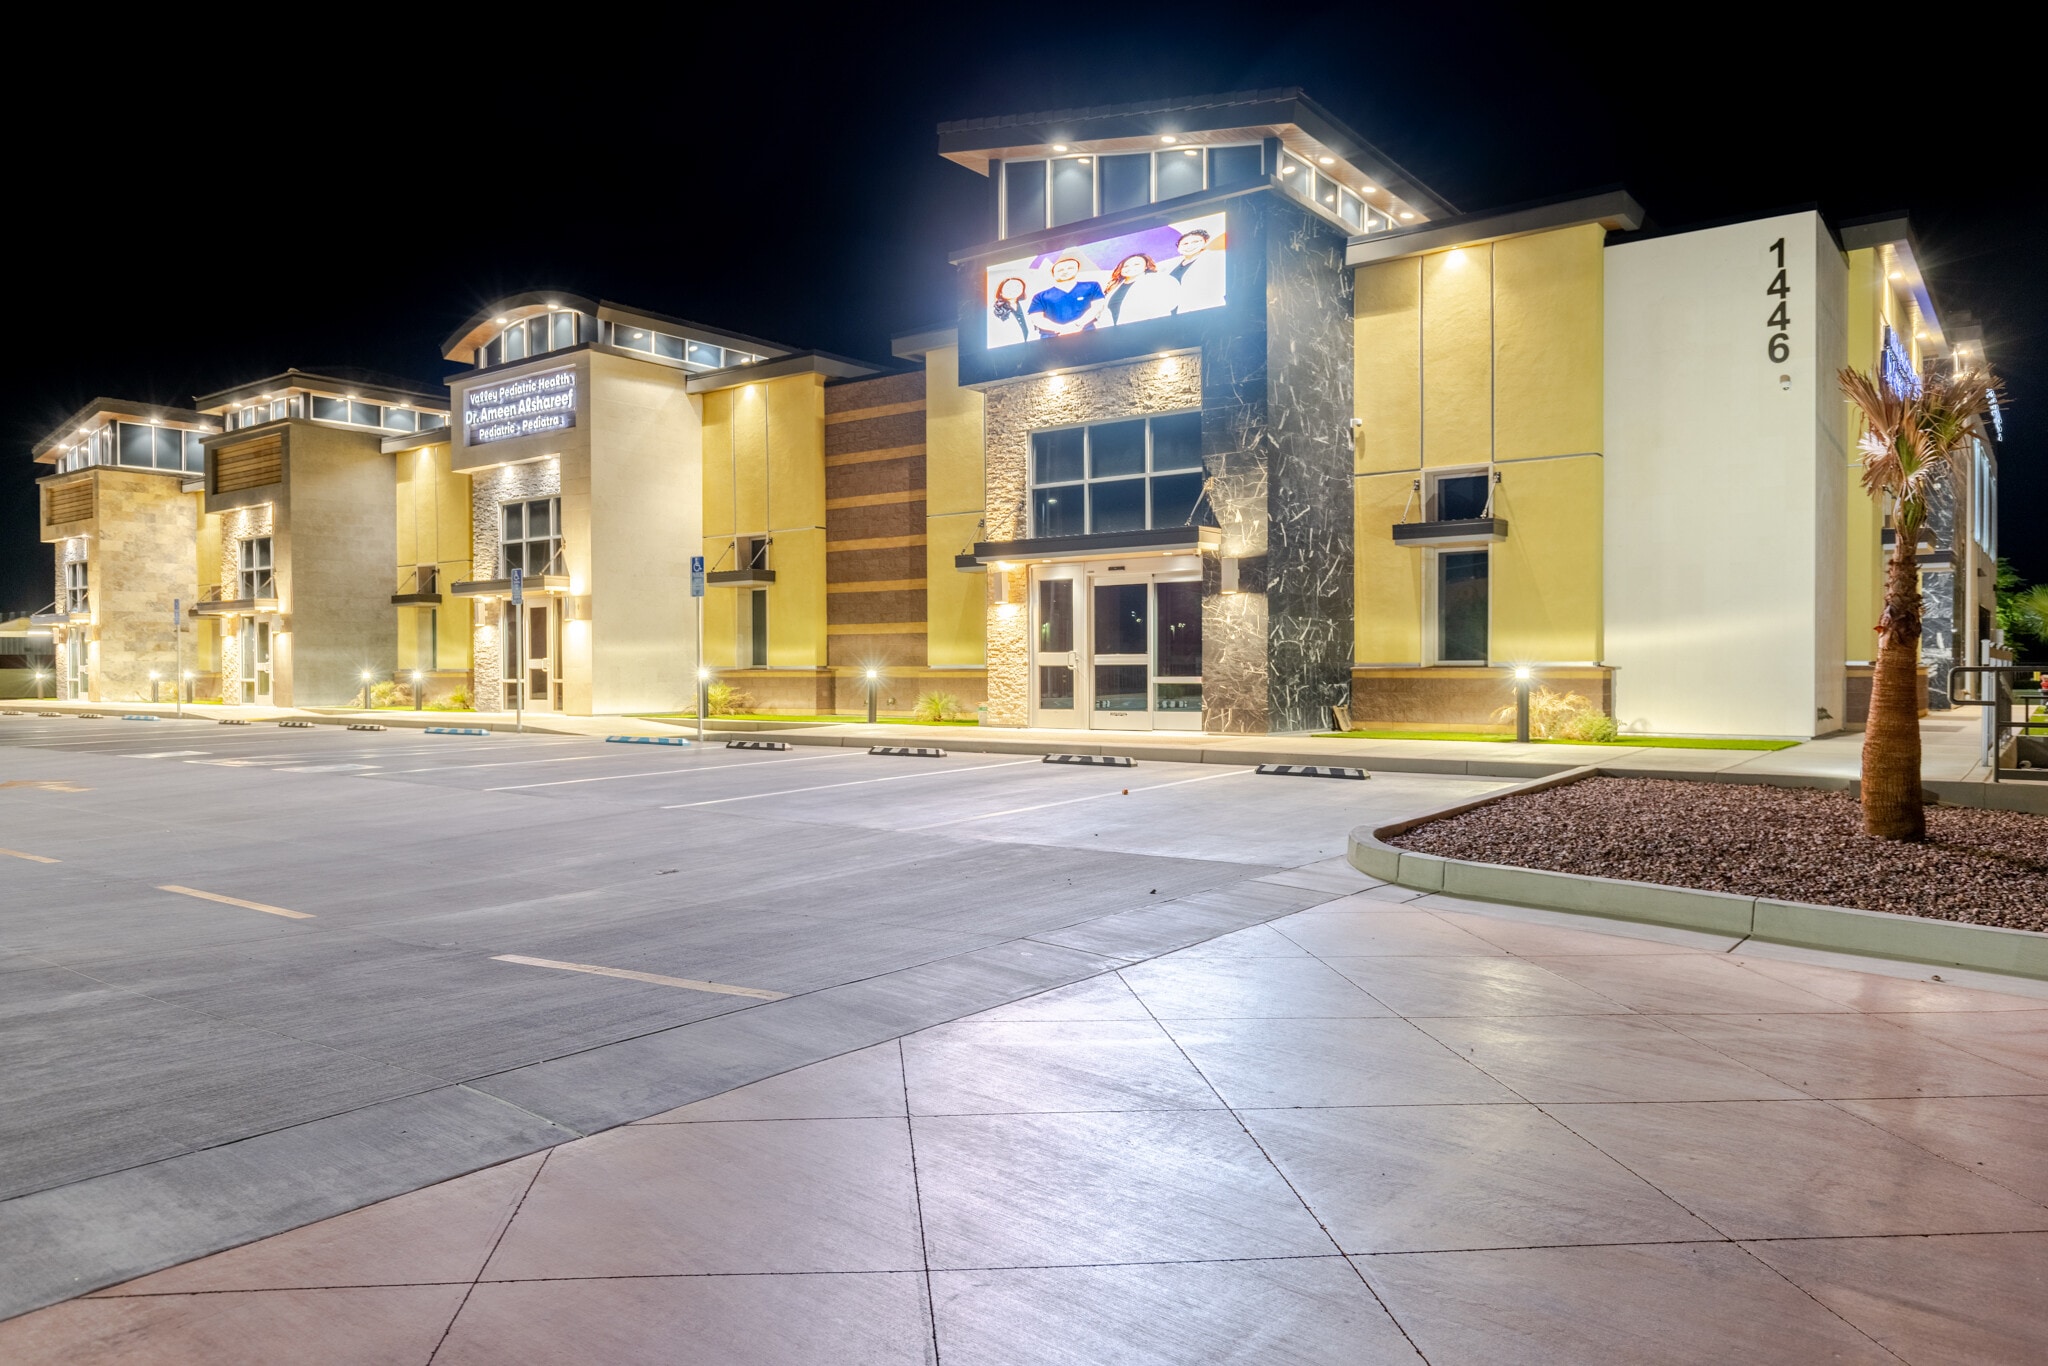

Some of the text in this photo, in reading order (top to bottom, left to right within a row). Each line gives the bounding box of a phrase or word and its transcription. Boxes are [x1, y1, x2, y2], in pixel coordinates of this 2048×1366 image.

[1766, 237, 1791, 363] 1446
[470, 373, 570, 405] Valley Pediatric Health
[480, 405, 517, 421] Ameen
[518, 389, 574, 414] Alshareef
[479, 422, 515, 440] Pediatric
[522, 415, 559, 431] Pediatra
